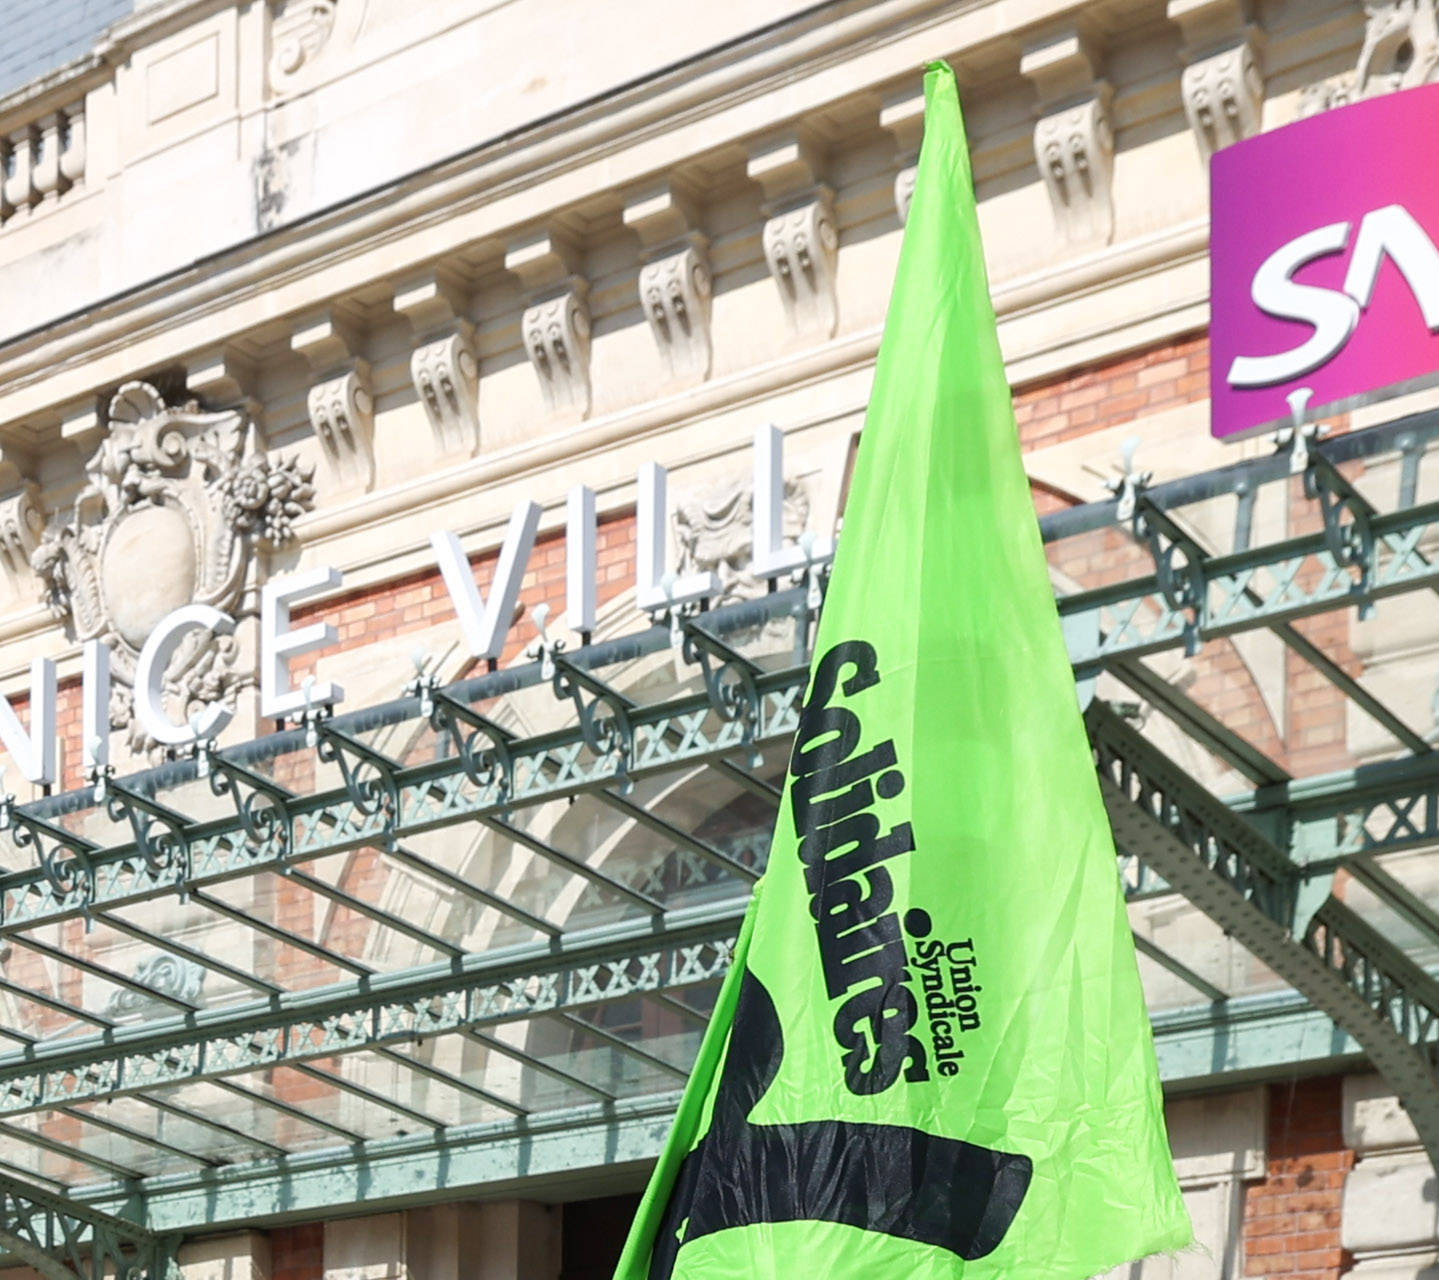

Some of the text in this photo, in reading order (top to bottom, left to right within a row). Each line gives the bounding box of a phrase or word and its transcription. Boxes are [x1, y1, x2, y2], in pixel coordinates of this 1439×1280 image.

[430, 423, 835, 660] VILL
[789, 640, 932, 1096] Solidaires
[911, 939, 960, 1077] Syndicale
[946, 938, 981, 1033] Union
